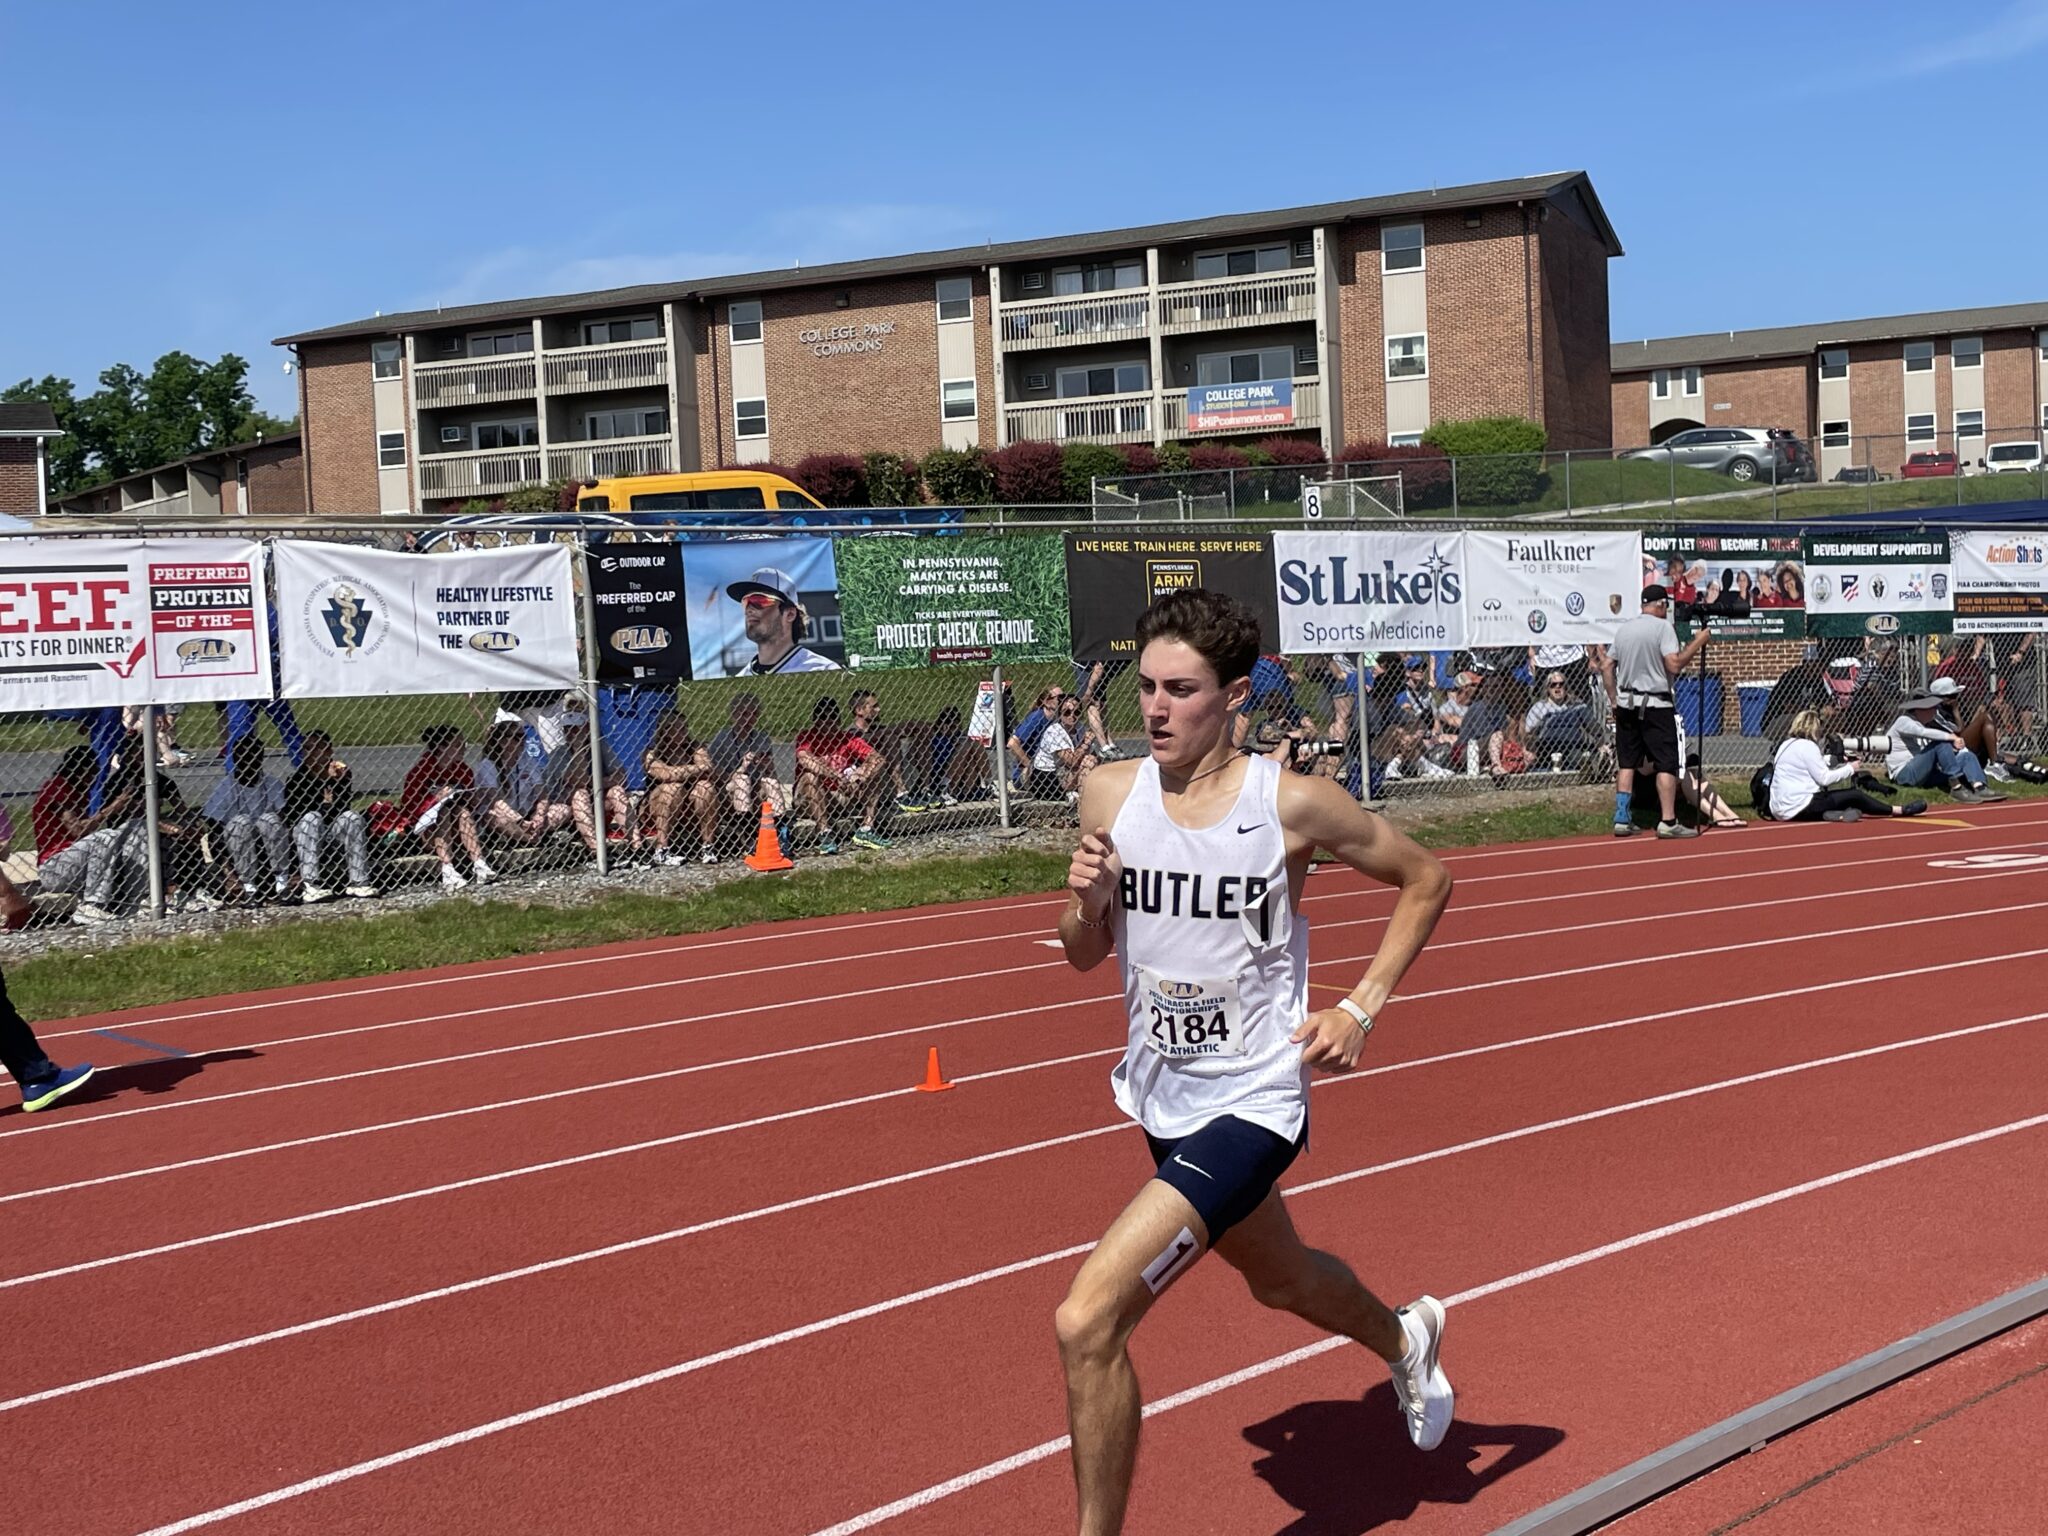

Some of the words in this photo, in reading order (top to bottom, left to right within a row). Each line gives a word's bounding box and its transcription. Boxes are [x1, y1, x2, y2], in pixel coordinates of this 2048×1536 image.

[800, 326, 857, 344] COLLEGE
[863, 321, 896, 337] PARK
[814, 338, 883, 358] COMMONS
[1206, 388, 1247, 402] COLLEGE
[1248, 386, 1274, 399] PARK
[1198, 413, 1285, 428] SHIPcommons.com
[1308, 495, 1319, 517] 8
[1076, 541, 1099, 552] LIVE
[1101, 541, 1132, 551] HERE.
[1134, 541, 1166, 551] TRAIN
[1168, 541, 1199, 551] HERE.
[1200, 541, 1232, 551] SERVE
[1235, 541, 1264, 551] HERE.
[1507, 539, 1595, 562] Faulkner
[1644, 537, 1677, 551] DON'T
[1679, 537, 1696, 551] LET
[1720, 538, 1759, 551] BECOME
[1761, 538, 1768, 551] A
[1813, 544, 1878, 556] DEVELOPMENT
[1880, 543, 1932, 556] SUPPORTED
[1933, 543, 1943, 555] BY
[619, 556, 651, 567] OUTDOOR
[652, 556, 666, 567] CAP
[902, 559, 915, 569] IN
[919, 556, 1003, 569] PENNSYLVANIA,
[1522, 564, 1537, 574] TO
[1541, 564, 1553, 574] BE
[1557, 563, 1581, 574] SURE
[153, 566, 249, 581] PREFERRED
[910, 571, 944, 582] MANY
[945, 570, 975, 581] TICKS
[979, 570, 998, 580] ARE
[1154, 575, 1194, 586] ARMY
[629, 582, 642, 590] The
[899, 584, 955, 595] CARRYING
[958, 584, 966, 594] A
[968, 582, 1012, 594] DISEASE.
[154, 588, 250, 606] PROTEIN
[436, 587, 489, 602] HEALTHY
[491, 586, 553, 602] LIFESTYLE
[596, 592, 653, 605] PREFERRED
[655, 590, 676, 602] CAP
[1899, 591, 1922, 599] PSBA
[627, 605, 634, 613] of
[635, 605, 646, 613] the
[915, 611, 935, 619] TICKS
[936, 611, 951, 619] ARE
[952, 609, 1000, 618] EVERYWHERE.
[175, 615, 197, 628] OF
[199, 614, 233, 627] THE
[437, 611, 492, 626] PARTNER
[495, 610, 510, 626] OF
[1473, 615, 1513, 623] INFINITI
[616, 627, 668, 650] PIAA
[876, 623, 935, 650] PROTECT.
[938, 621, 983, 647] CHECK.
[986, 619, 1039, 644] REMOVE.
[1303, 621, 1365, 645] Sports
[1370, 620, 1445, 640] Medicine
[0, 639, 25, 658] T'S
[31, 639, 62, 656] FOR
[68, 636, 130, 655] DINNER.
[438, 634, 463, 649] THE
[0, 676, 31, 685] armers
[34, 675, 48, 683] and
[51, 674, 88, 682] Ranchers
[1121, 867, 1268, 920] BUTLER
[1153, 999, 1220, 1014] CHAMPIONSHIPS
[1164, 998, 1191, 1008] TRACK
[1202, 996, 1226, 1006] FIELD
[1150, 1005, 1230, 1045] 2184
[1170, 1044, 1220, 1056] ATHLETIC
[1151, 1241, 1195, 1285] 1
